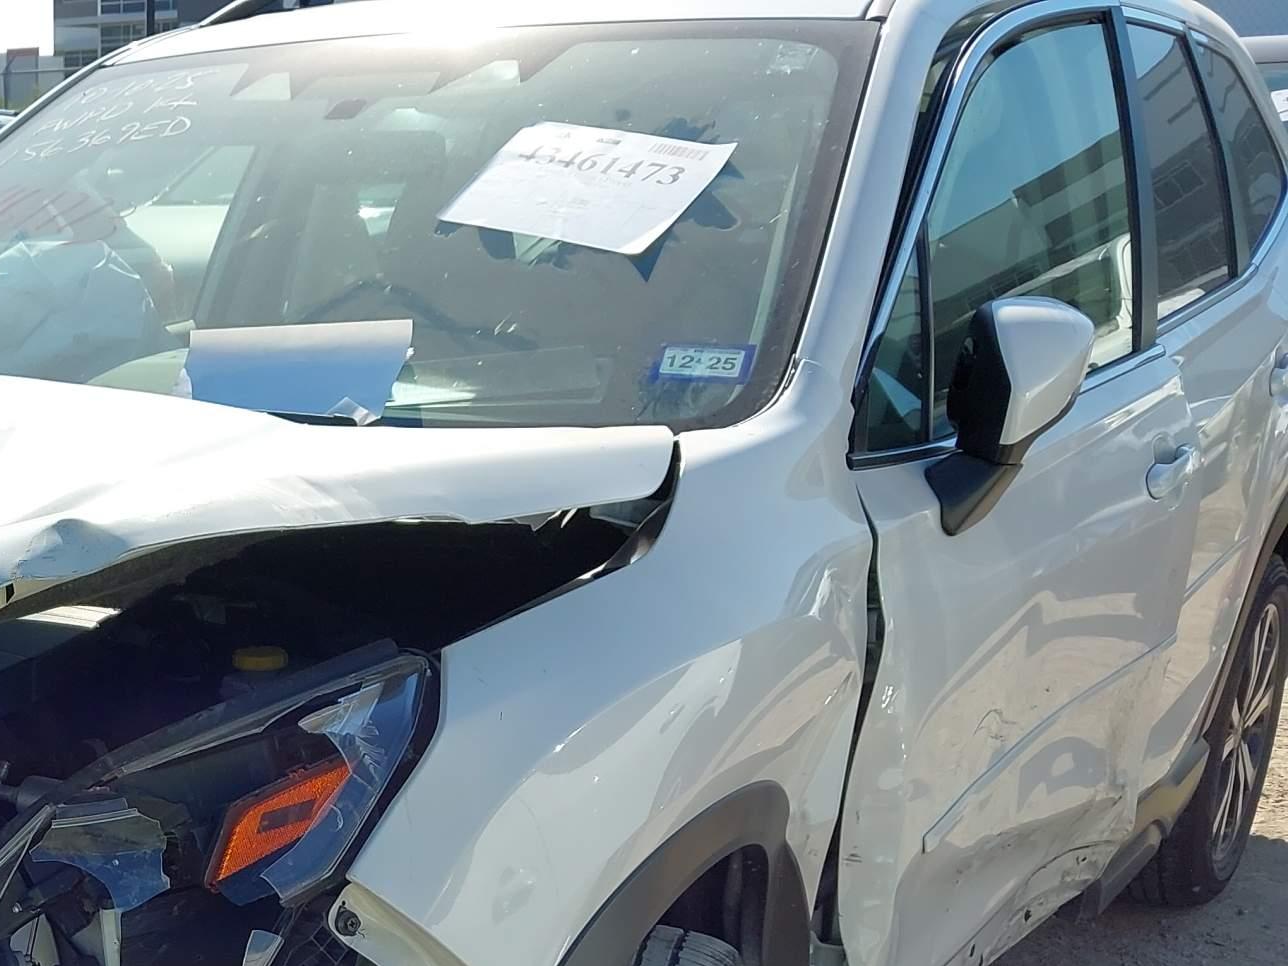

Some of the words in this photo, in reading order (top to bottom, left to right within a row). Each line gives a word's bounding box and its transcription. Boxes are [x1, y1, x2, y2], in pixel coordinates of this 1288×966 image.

[517, 145, 686, 186] 43461473
[666, 354, 695, 369] 12
[705, 356, 738, 371] 25
